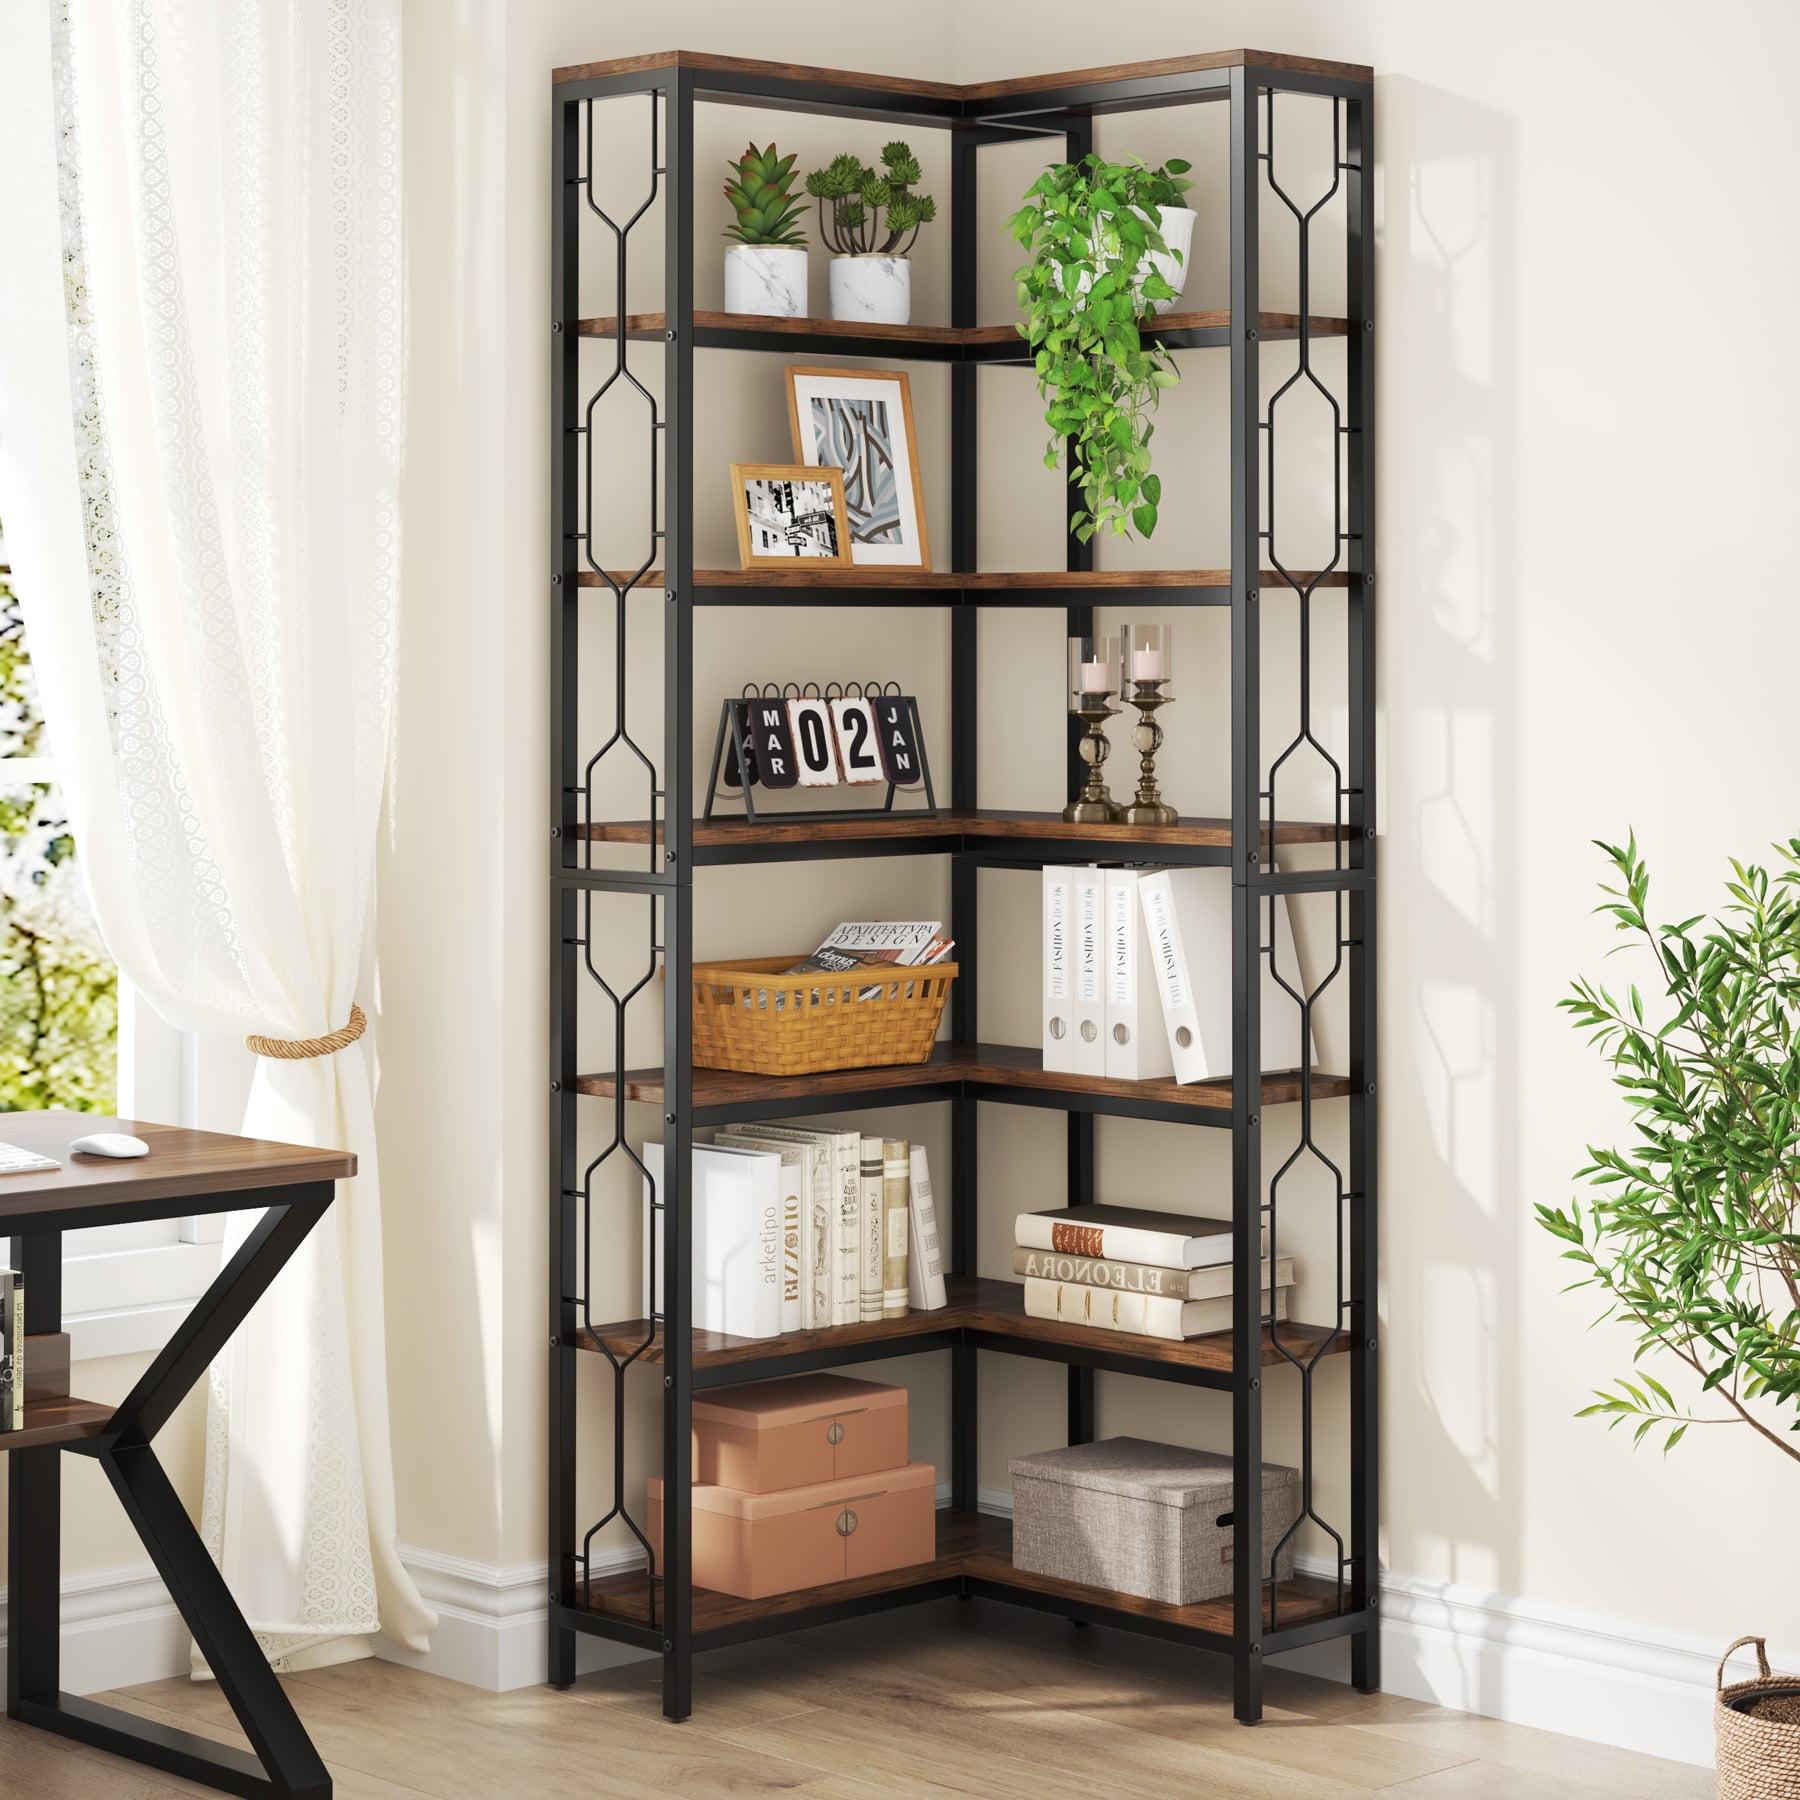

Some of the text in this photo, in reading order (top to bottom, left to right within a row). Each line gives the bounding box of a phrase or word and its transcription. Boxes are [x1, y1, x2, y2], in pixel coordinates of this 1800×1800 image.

[763, 709, 786, 775] MAR
[887, 707, 910, 770] JAN
[818, 950, 857, 966] domus
[834, 934, 924, 945] DESIGN
[1053, 920, 1063, 971] FASHION
[1083, 923, 1094, 974] FASHION
[1115, 925, 1126, 976] FASHION
[1158, 928, 1177, 981] FASHION
[758, 1206, 780, 1284] arketipo
